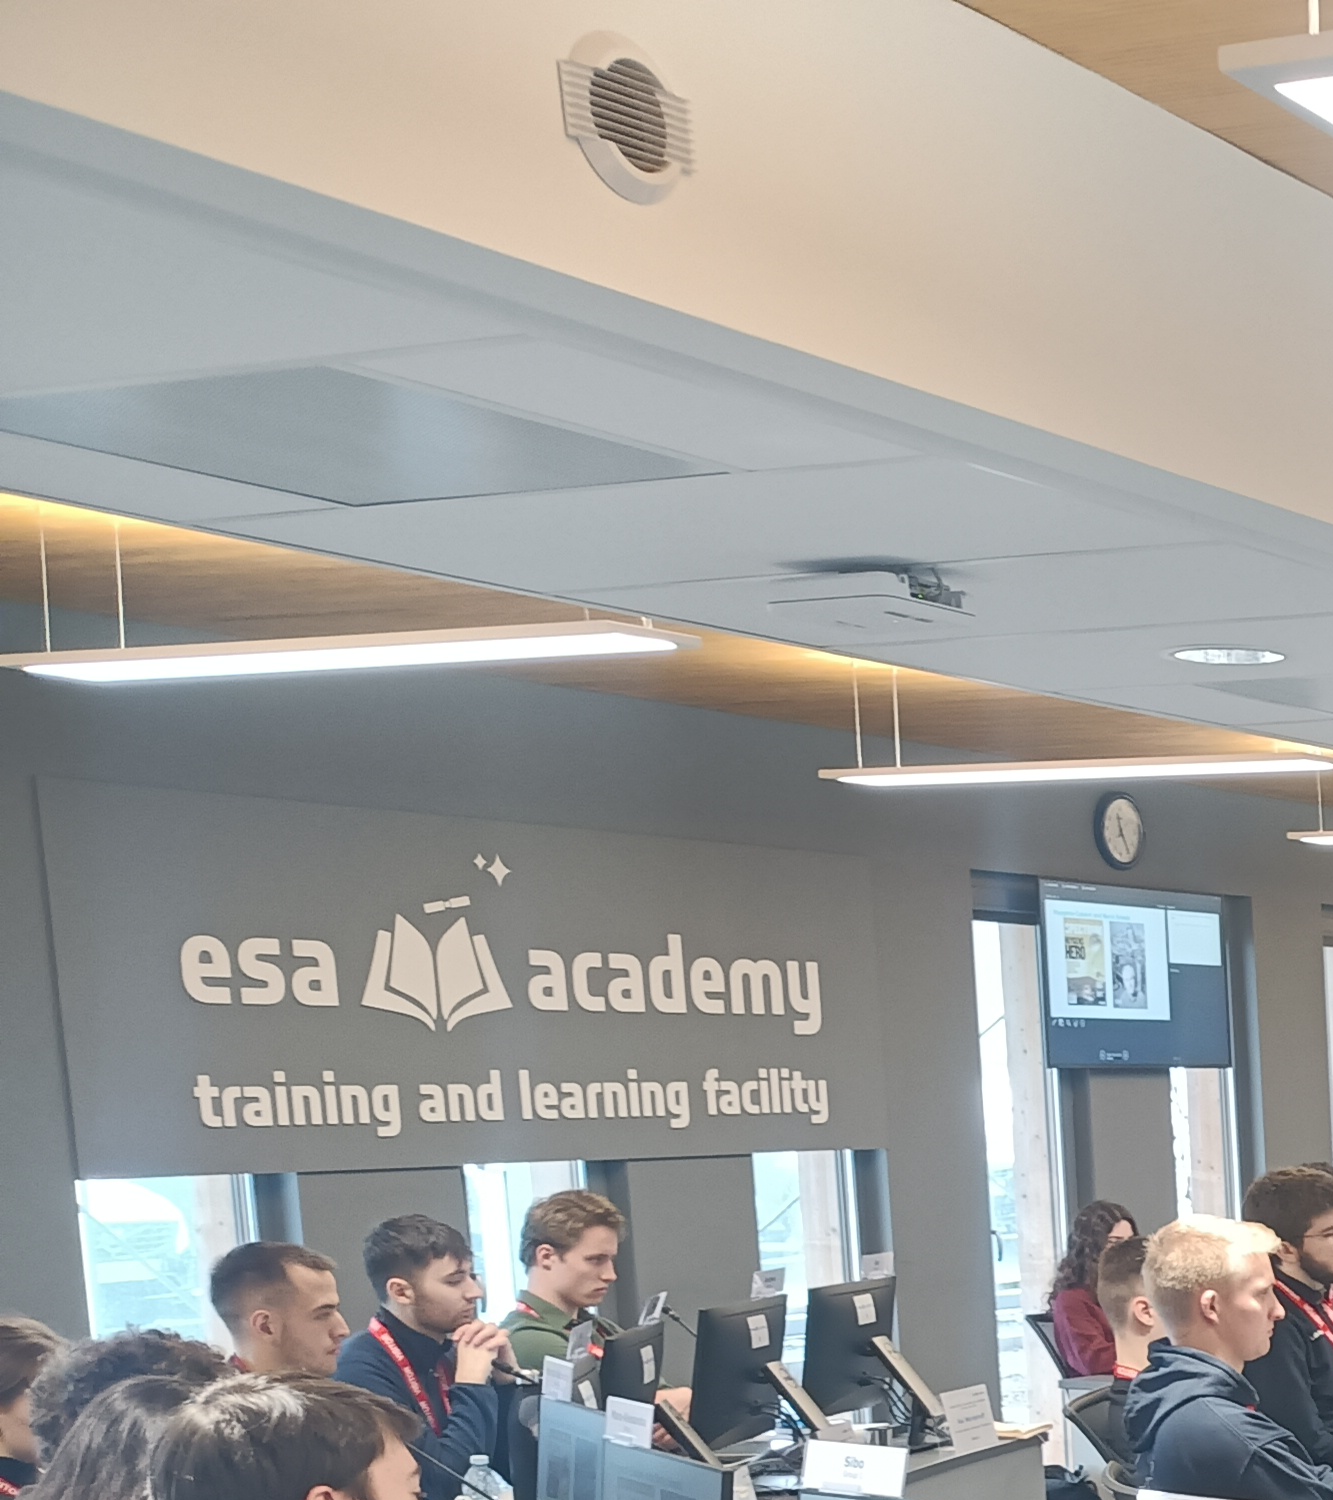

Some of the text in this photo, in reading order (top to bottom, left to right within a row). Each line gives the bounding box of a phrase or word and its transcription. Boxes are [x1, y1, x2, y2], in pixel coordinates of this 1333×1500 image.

[180, 933, 823, 1036] esa academy
[193, 1067, 830, 1138] training and learning facility
[844, 1455, 865, 1470] Sibo
